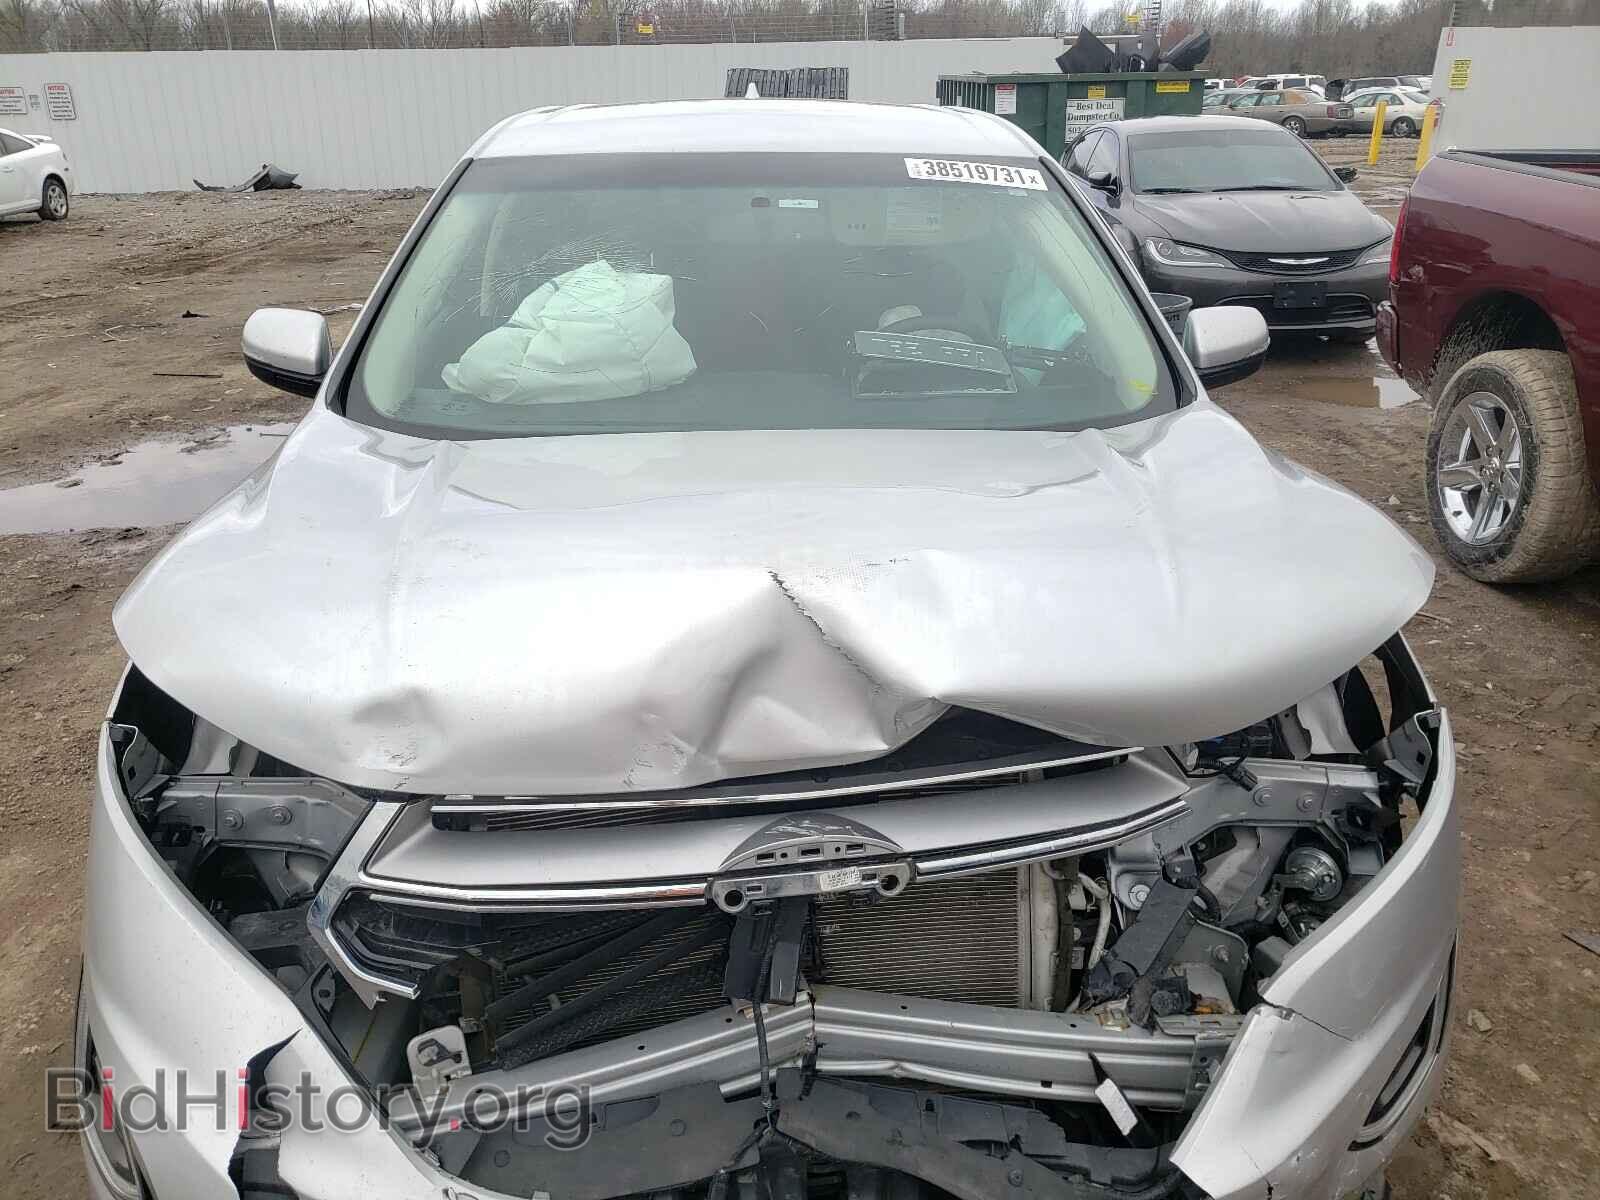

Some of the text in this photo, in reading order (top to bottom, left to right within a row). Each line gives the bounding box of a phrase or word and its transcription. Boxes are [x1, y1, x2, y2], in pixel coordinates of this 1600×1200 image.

[1076, 101, 1114, 110] Best Deal
[1067, 113, 1108, 122] Dumpster
[922, 161, 1026, 184] 38519731
